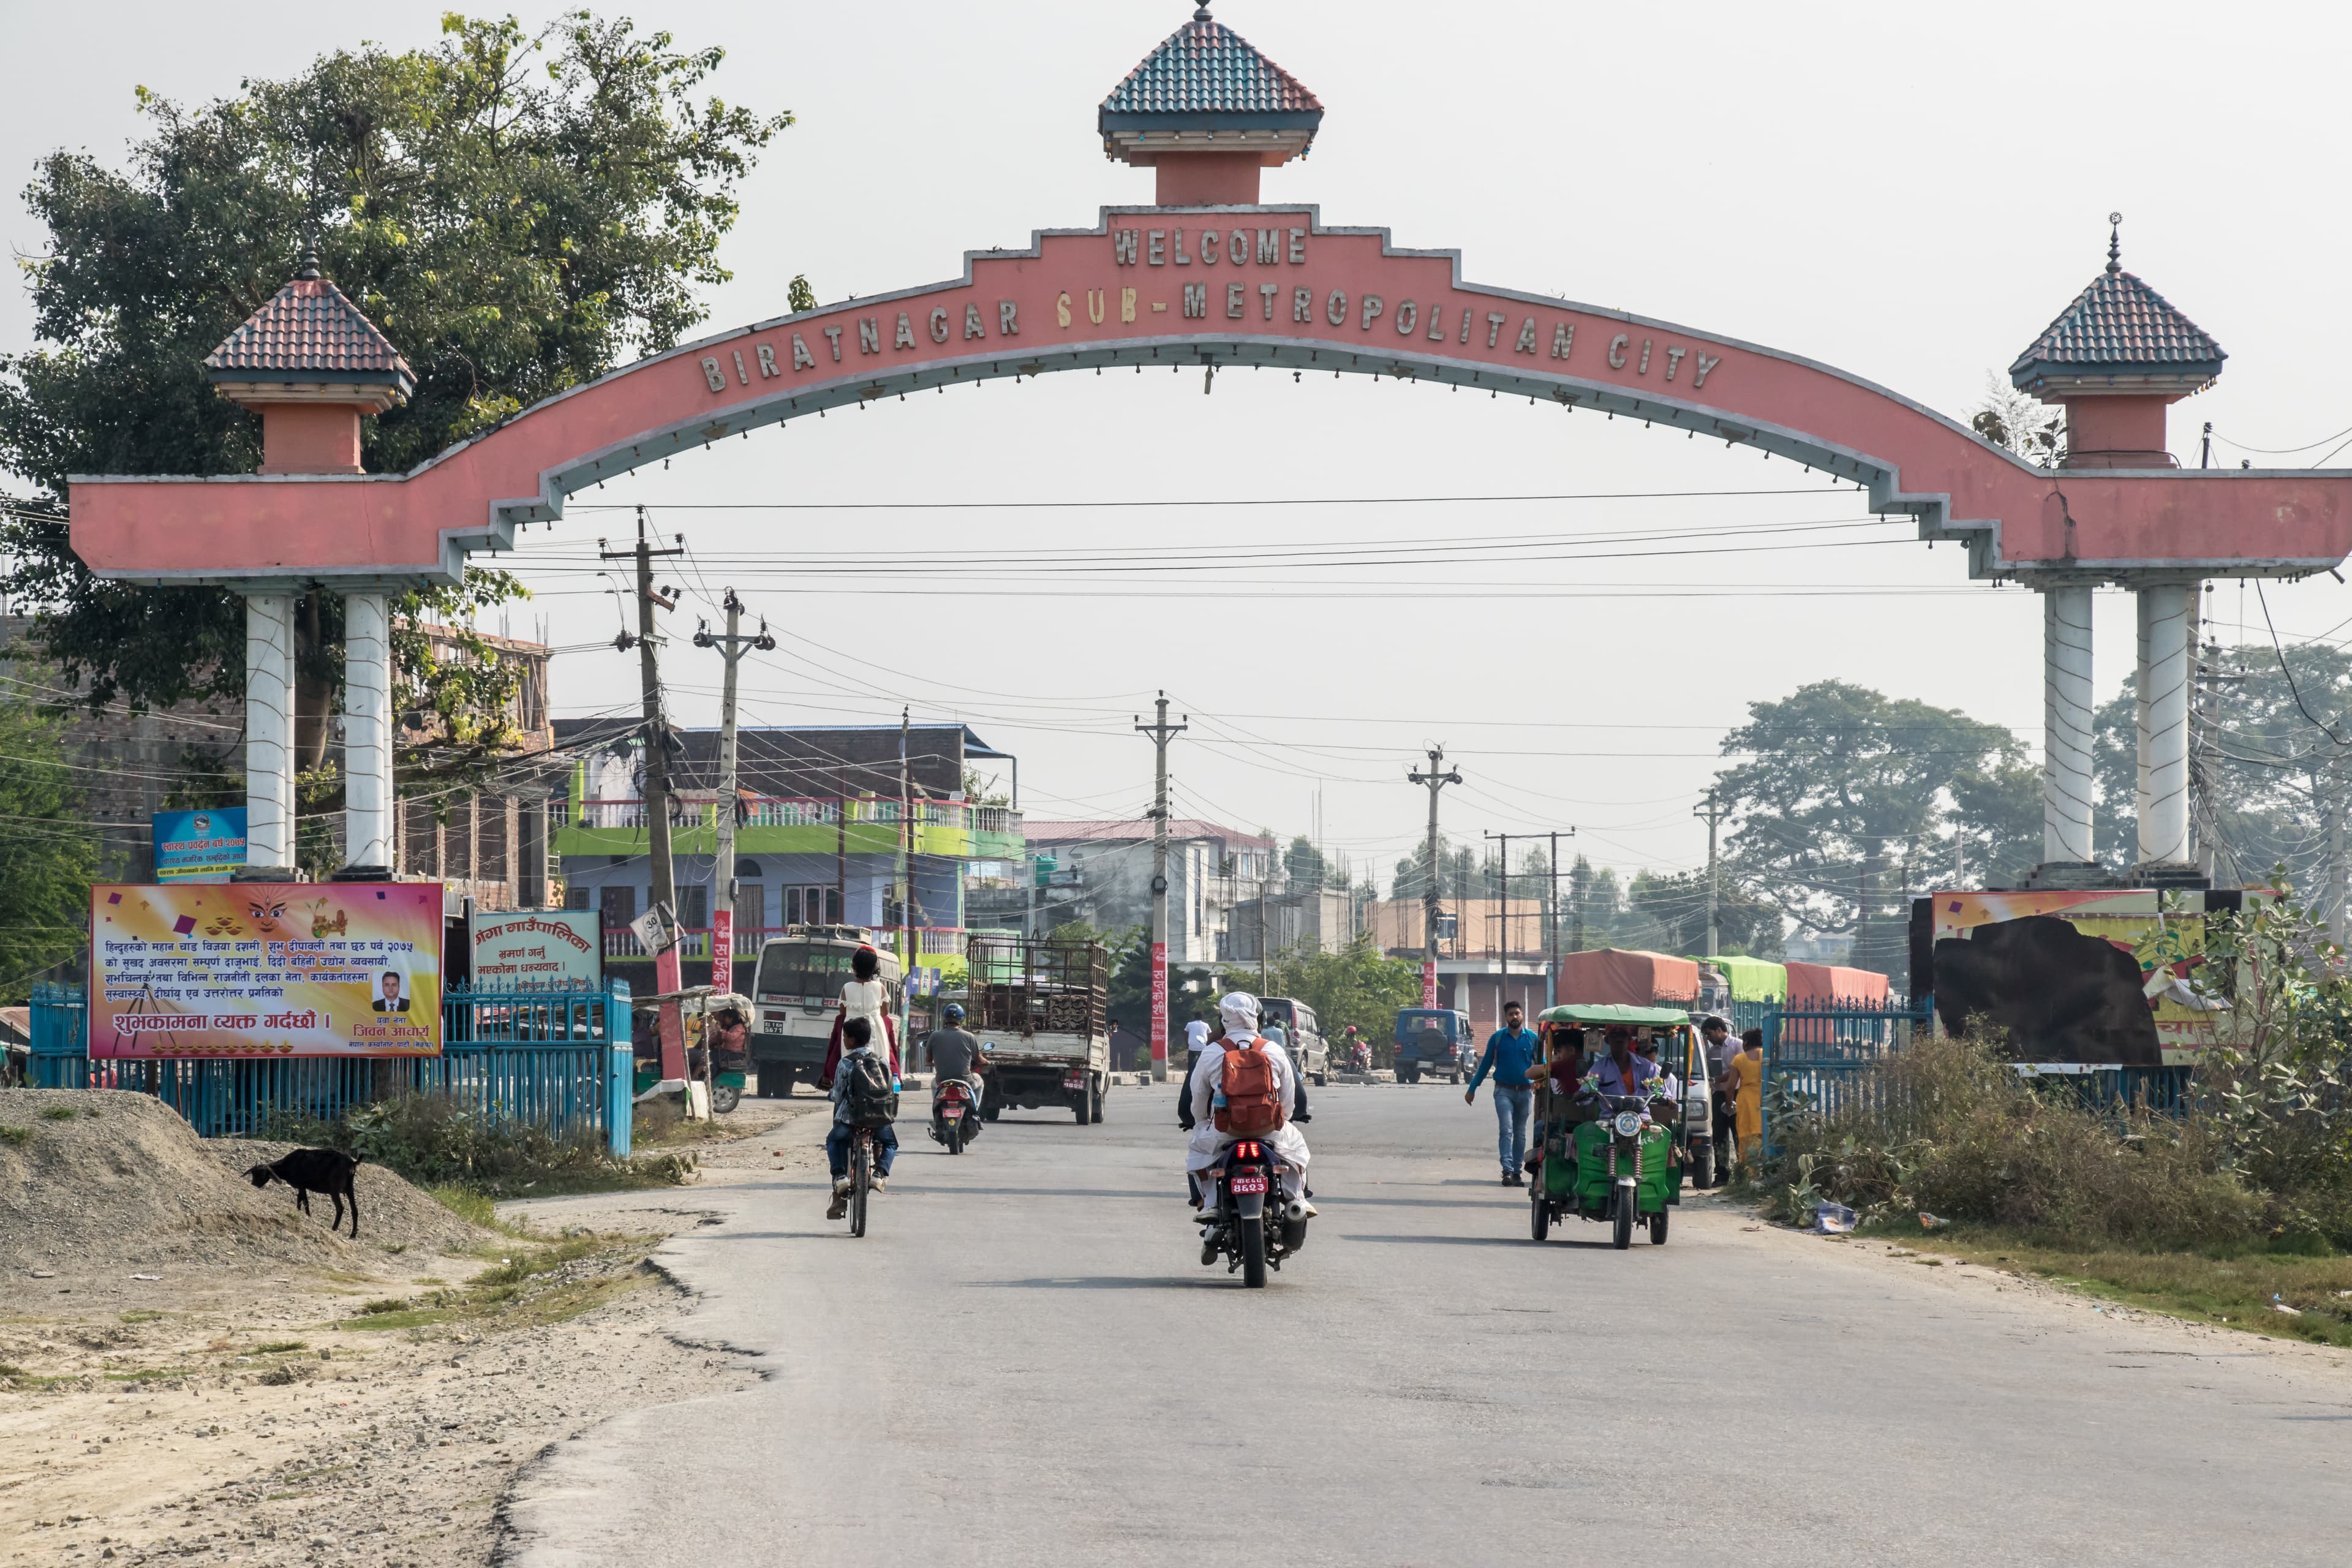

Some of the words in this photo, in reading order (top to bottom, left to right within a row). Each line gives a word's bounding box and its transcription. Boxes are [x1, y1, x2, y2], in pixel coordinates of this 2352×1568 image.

[1114, 228, 1306, 265] WELCOME
[700, 299, 1020, 393] BIRATNAGAR
[1608, 334, 1721, 388] CITY
[646, 917, 657, 929] 30
[475, 925, 503, 946] गंगा
[505, 916, 592, 954] गाउँपालिका
[152, 943, 175, 952] महान
[179, 943, 198, 952] चाड
[203, 940, 230, 951] विजया
[235, 940, 263, 952] दशमी,
[268, 942, 284, 954] शुभ
[288, 940, 325, 952] दीपावली
[330, 942, 347, 951] तथा
[350, 942, 366, 952] छठ
[370, 940, 383, 951] पर्व
[388, 942, 413, 952] २०७५
[528, 946, 546, 960] गर्नु
[105, 957, 118, 967] को
[123, 959, 145, 970] सुखद
[149, 959, 188, 968] अवसरमा
[192, 956, 221, 969] सम्पूर्ण
[225, 956, 262, 969] दाजुभाई,
[268, 955, 287, 967] दिदी
[320, 956, 346, 966] उद्योग
[350, 955, 390, 968] व्यवसायी,
[521, 962, 559, 973] धन्यवाद
[105, 971, 151, 986] शुभचिन्तक
[156, 974, 173, 982] तथा
[178, 971, 209, 982] विभिन्न
[213, 971, 251, 983] राजनीती
[255, 973, 281, 983] दलका
[285, 971, 304, 984] नेता,
[154, 987, 181, 1001] दीर्घायु
[186, 987, 200, 1000] एवं
[203, 987, 244, 999] उत्तरोत्तर
[248, 986, 284, 998] प्रगतिको
[115, 1014, 208, 1034] शुभकामना
[213, 1014, 258, 1030] व्यक्त
[376, 1017, 390, 1025] युवा
[393, 1016, 407, 1024] नेता
[353, 1023, 386, 1036] जिवन
[391, 1025, 430, 1037] आचार्य
